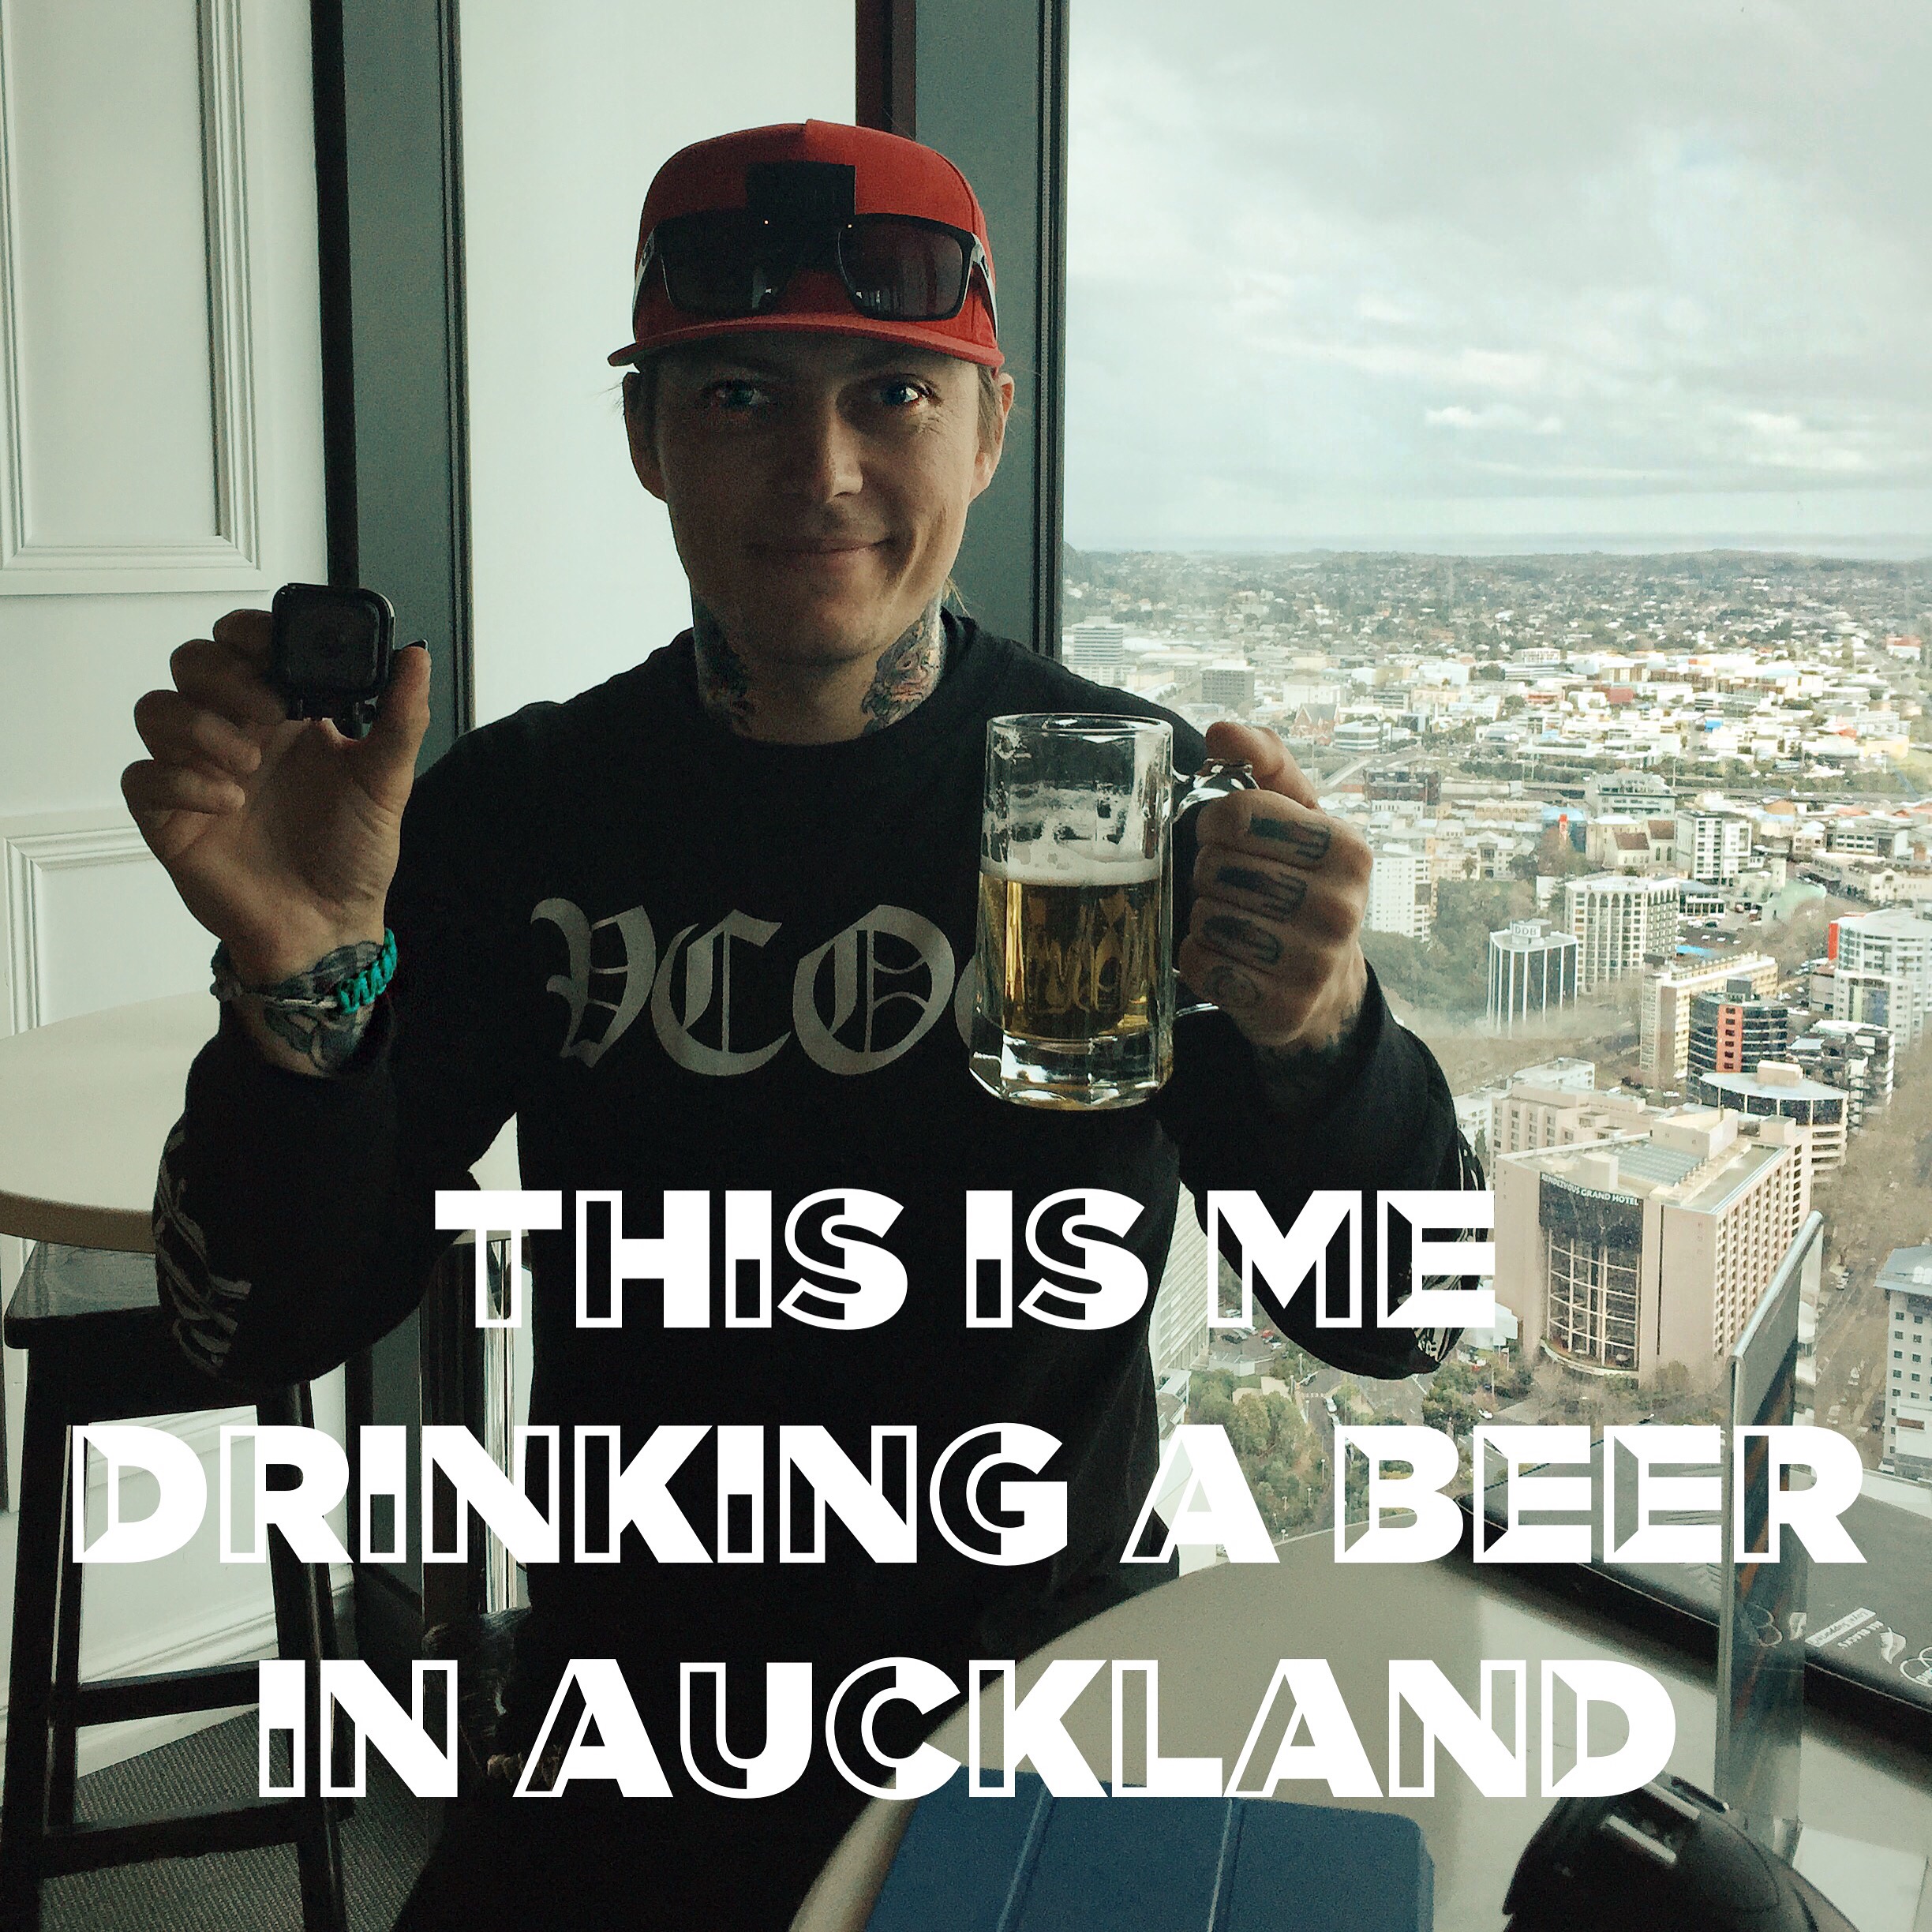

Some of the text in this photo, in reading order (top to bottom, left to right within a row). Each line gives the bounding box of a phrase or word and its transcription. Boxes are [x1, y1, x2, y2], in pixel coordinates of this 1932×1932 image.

[1515, 926, 1537, 936] DDB
[530, 897, 979, 1076] VCO
[1541, 1173, 1639, 1206] RENDEZVOUS GRAND HOTEL
